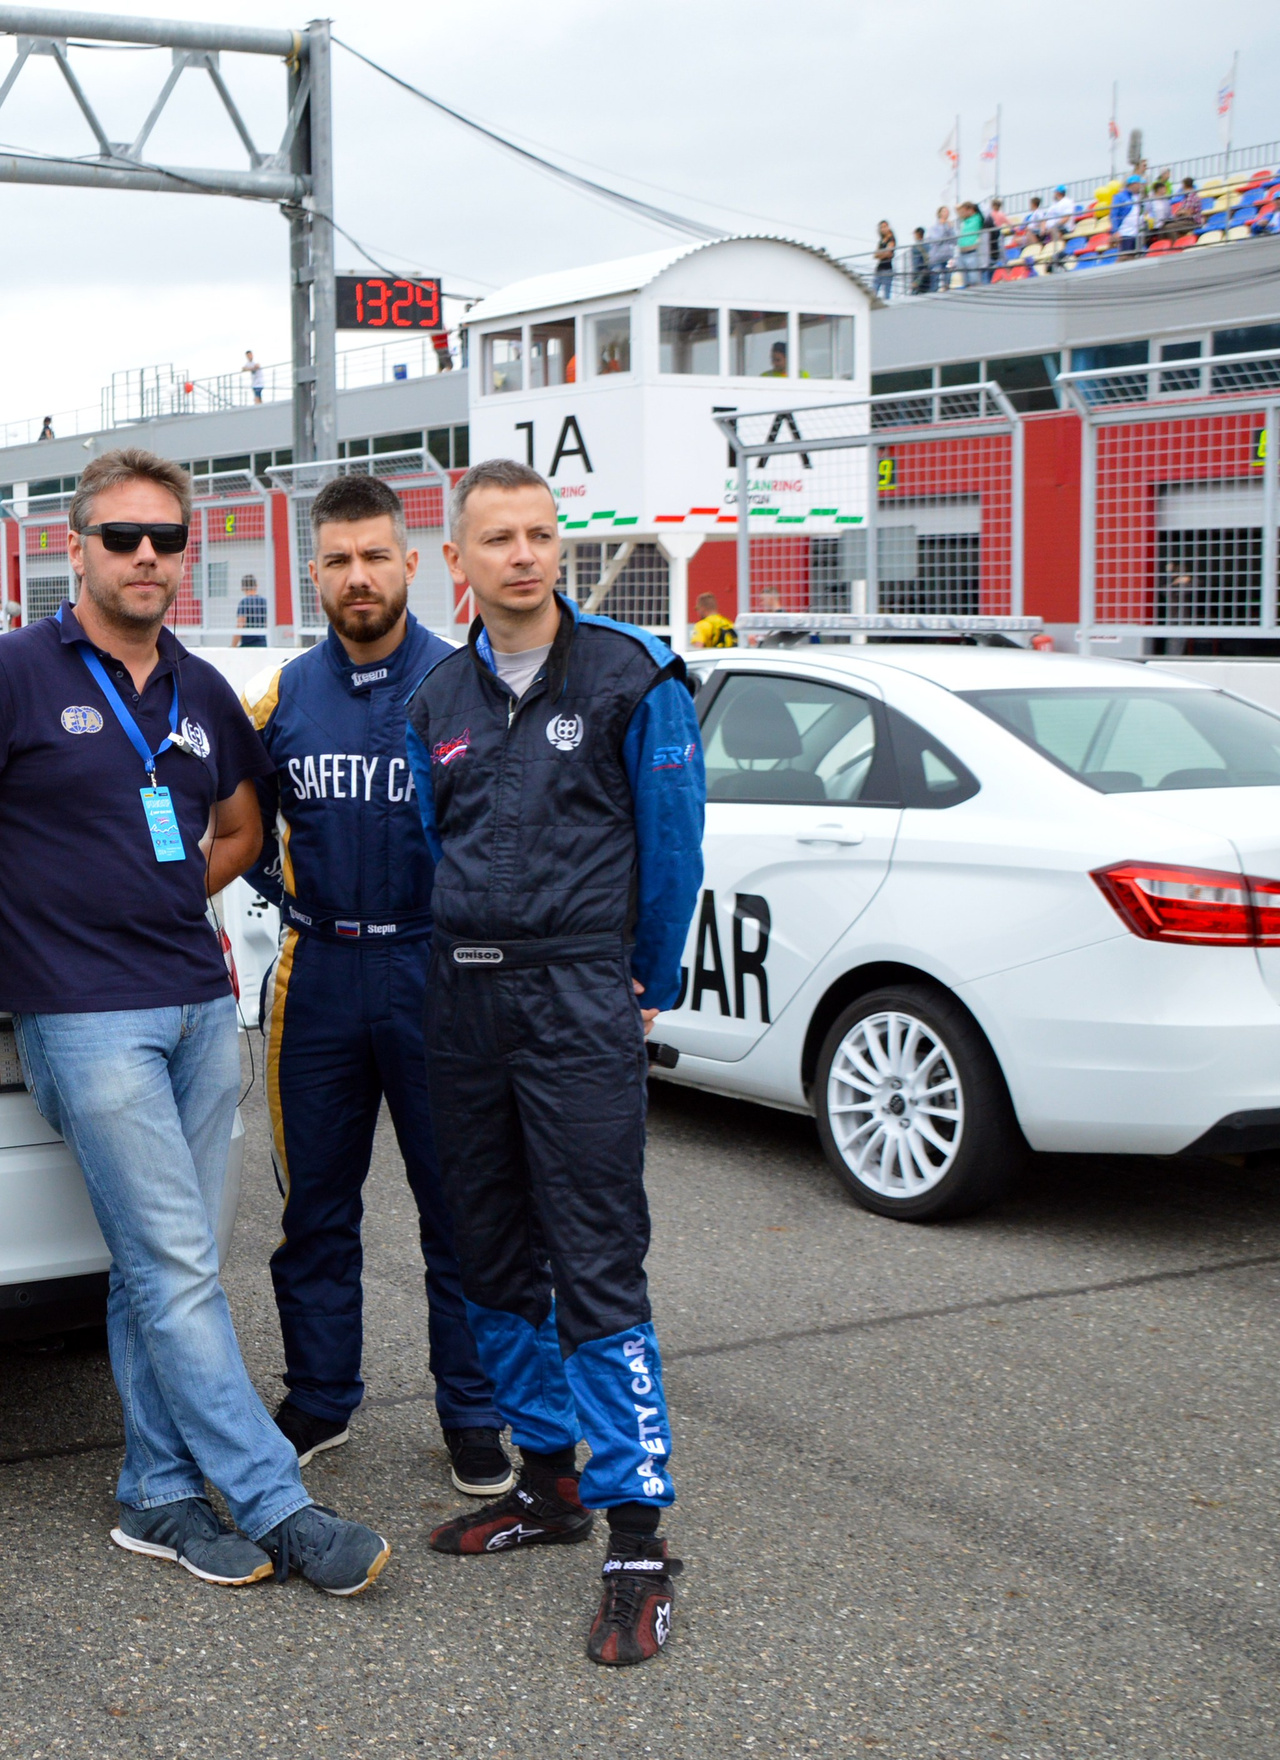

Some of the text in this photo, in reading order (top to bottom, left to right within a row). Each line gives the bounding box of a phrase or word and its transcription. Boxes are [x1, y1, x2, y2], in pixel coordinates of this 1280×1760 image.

[288, 754, 379, 801] SAFETY
[367, 923, 397, 935] Stepin
[622, 1336, 652, 1395] CAR
